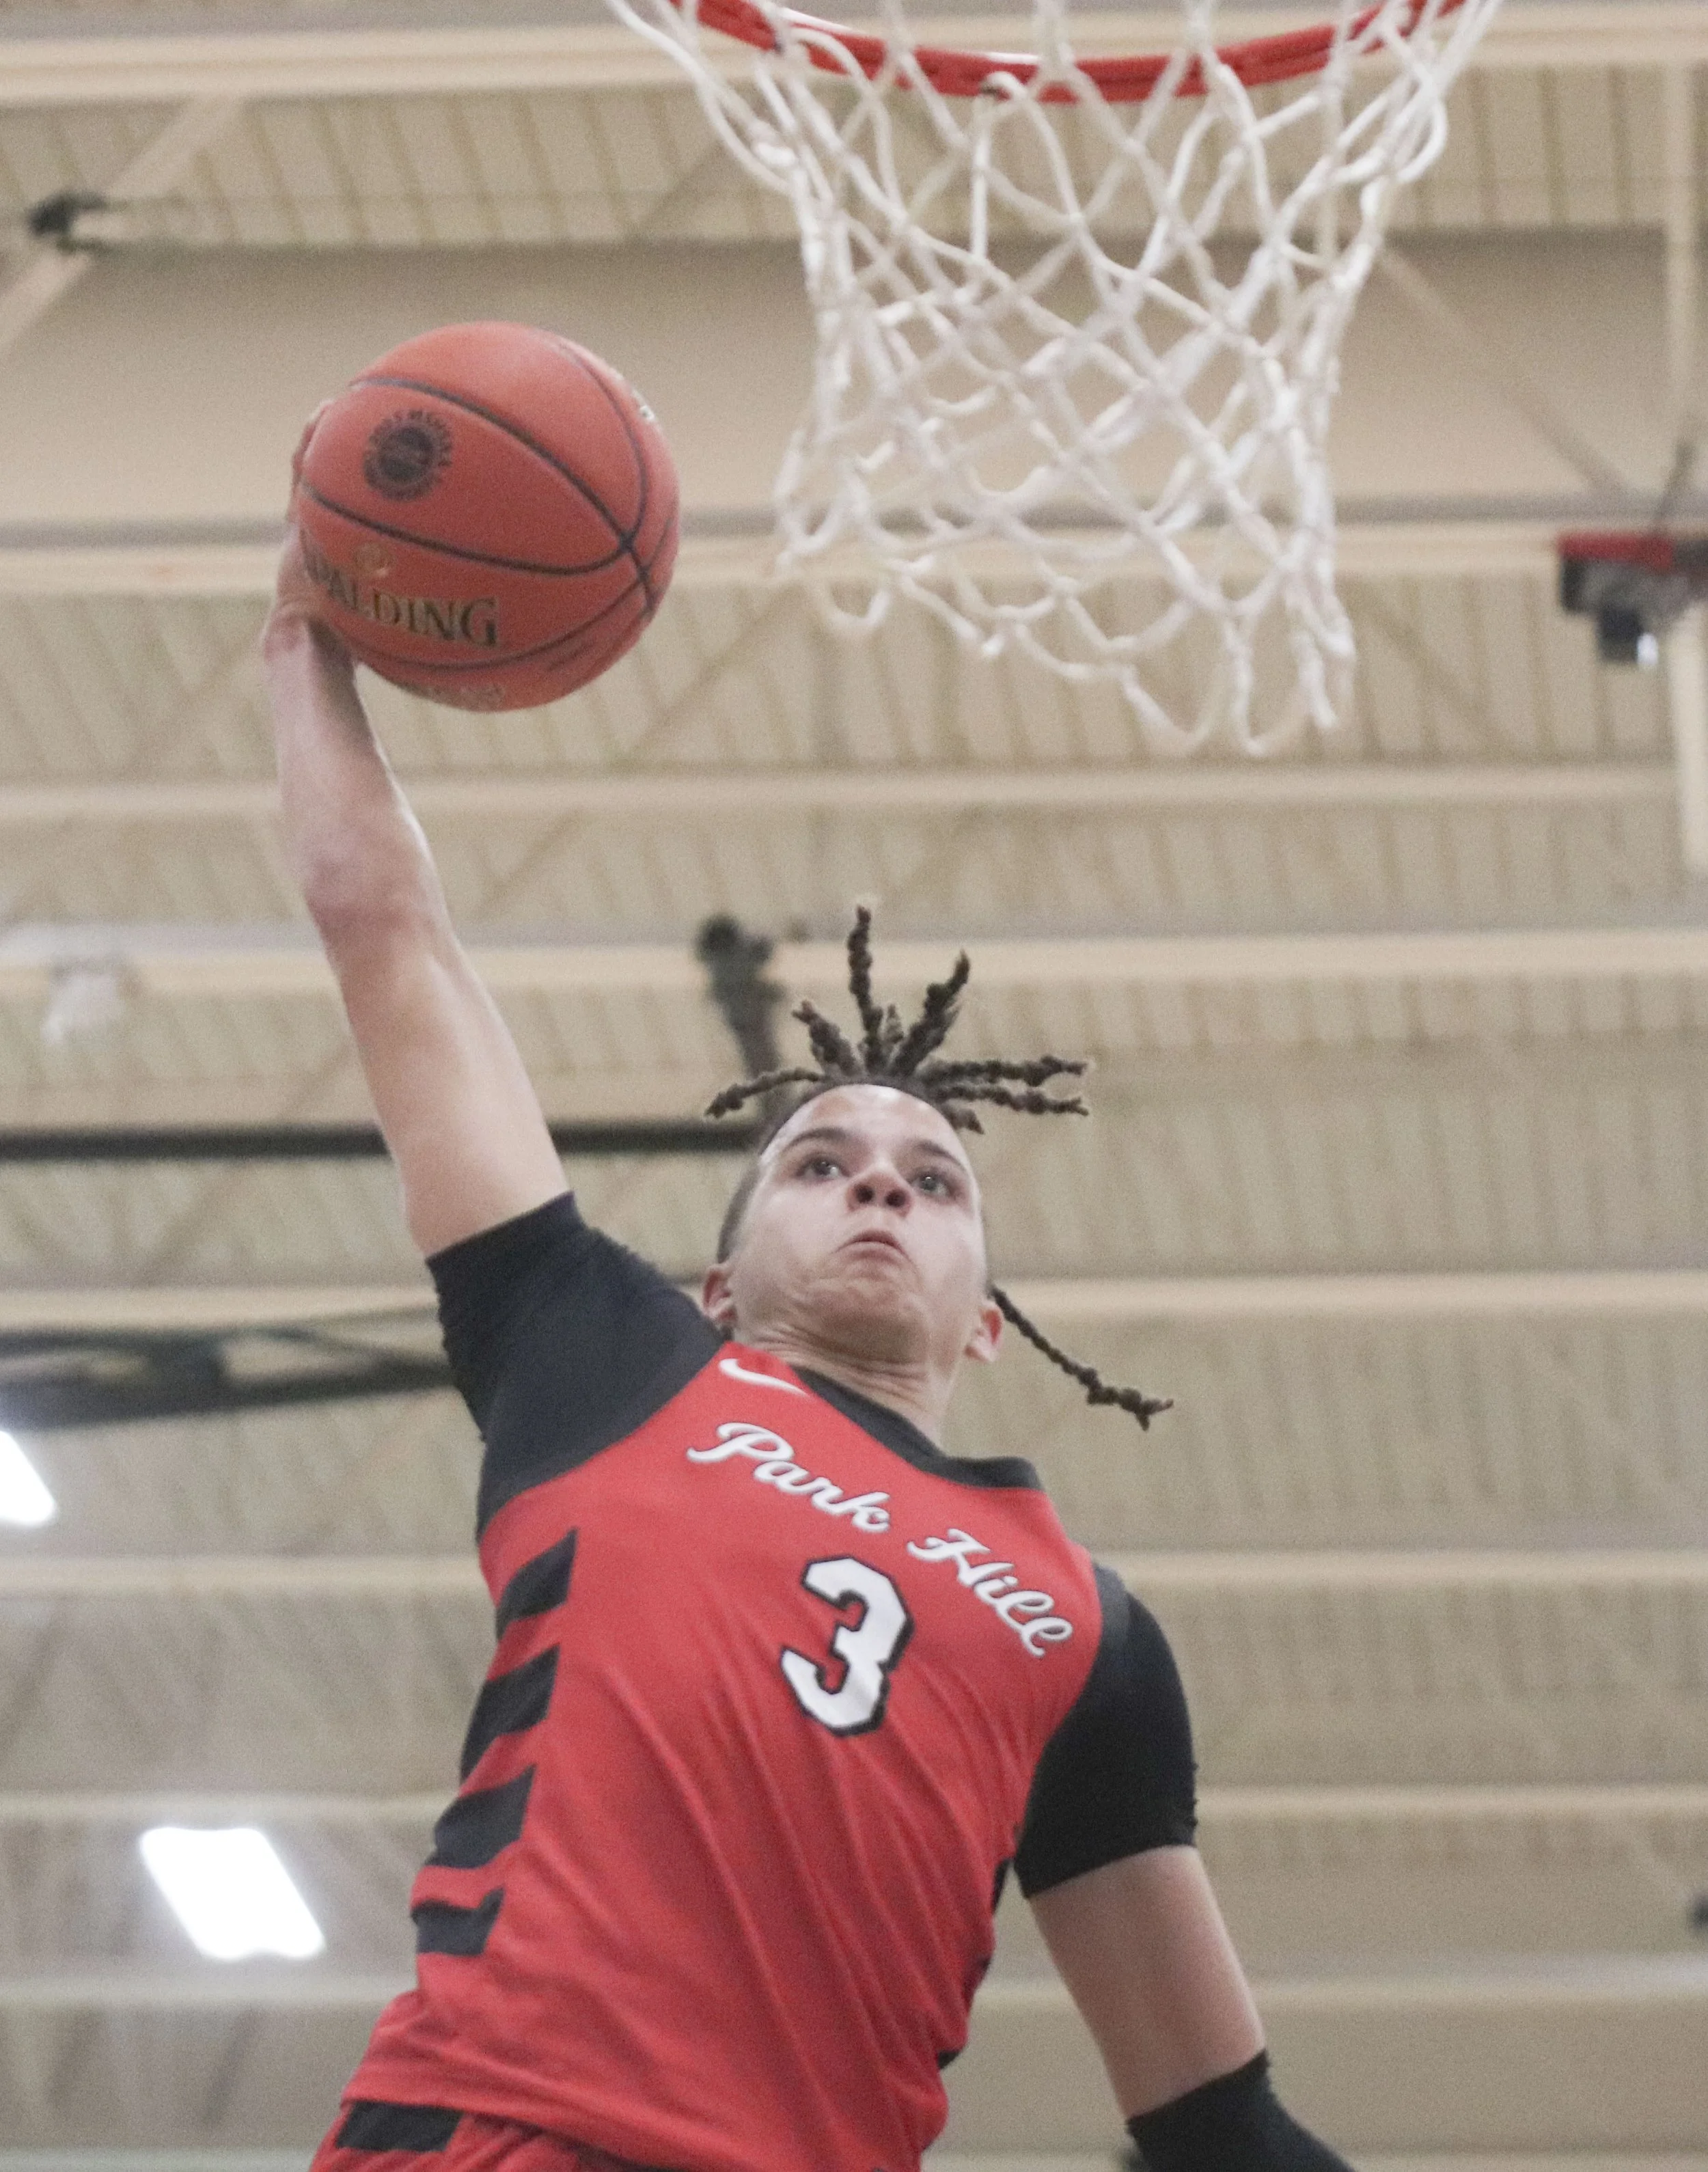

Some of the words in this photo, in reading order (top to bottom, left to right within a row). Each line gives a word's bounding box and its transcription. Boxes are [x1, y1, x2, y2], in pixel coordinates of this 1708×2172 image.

[686, 1422, 890, 1533] Park
[907, 1528, 1073, 1657] Hill
[780, 1556, 914, 1736] 3
